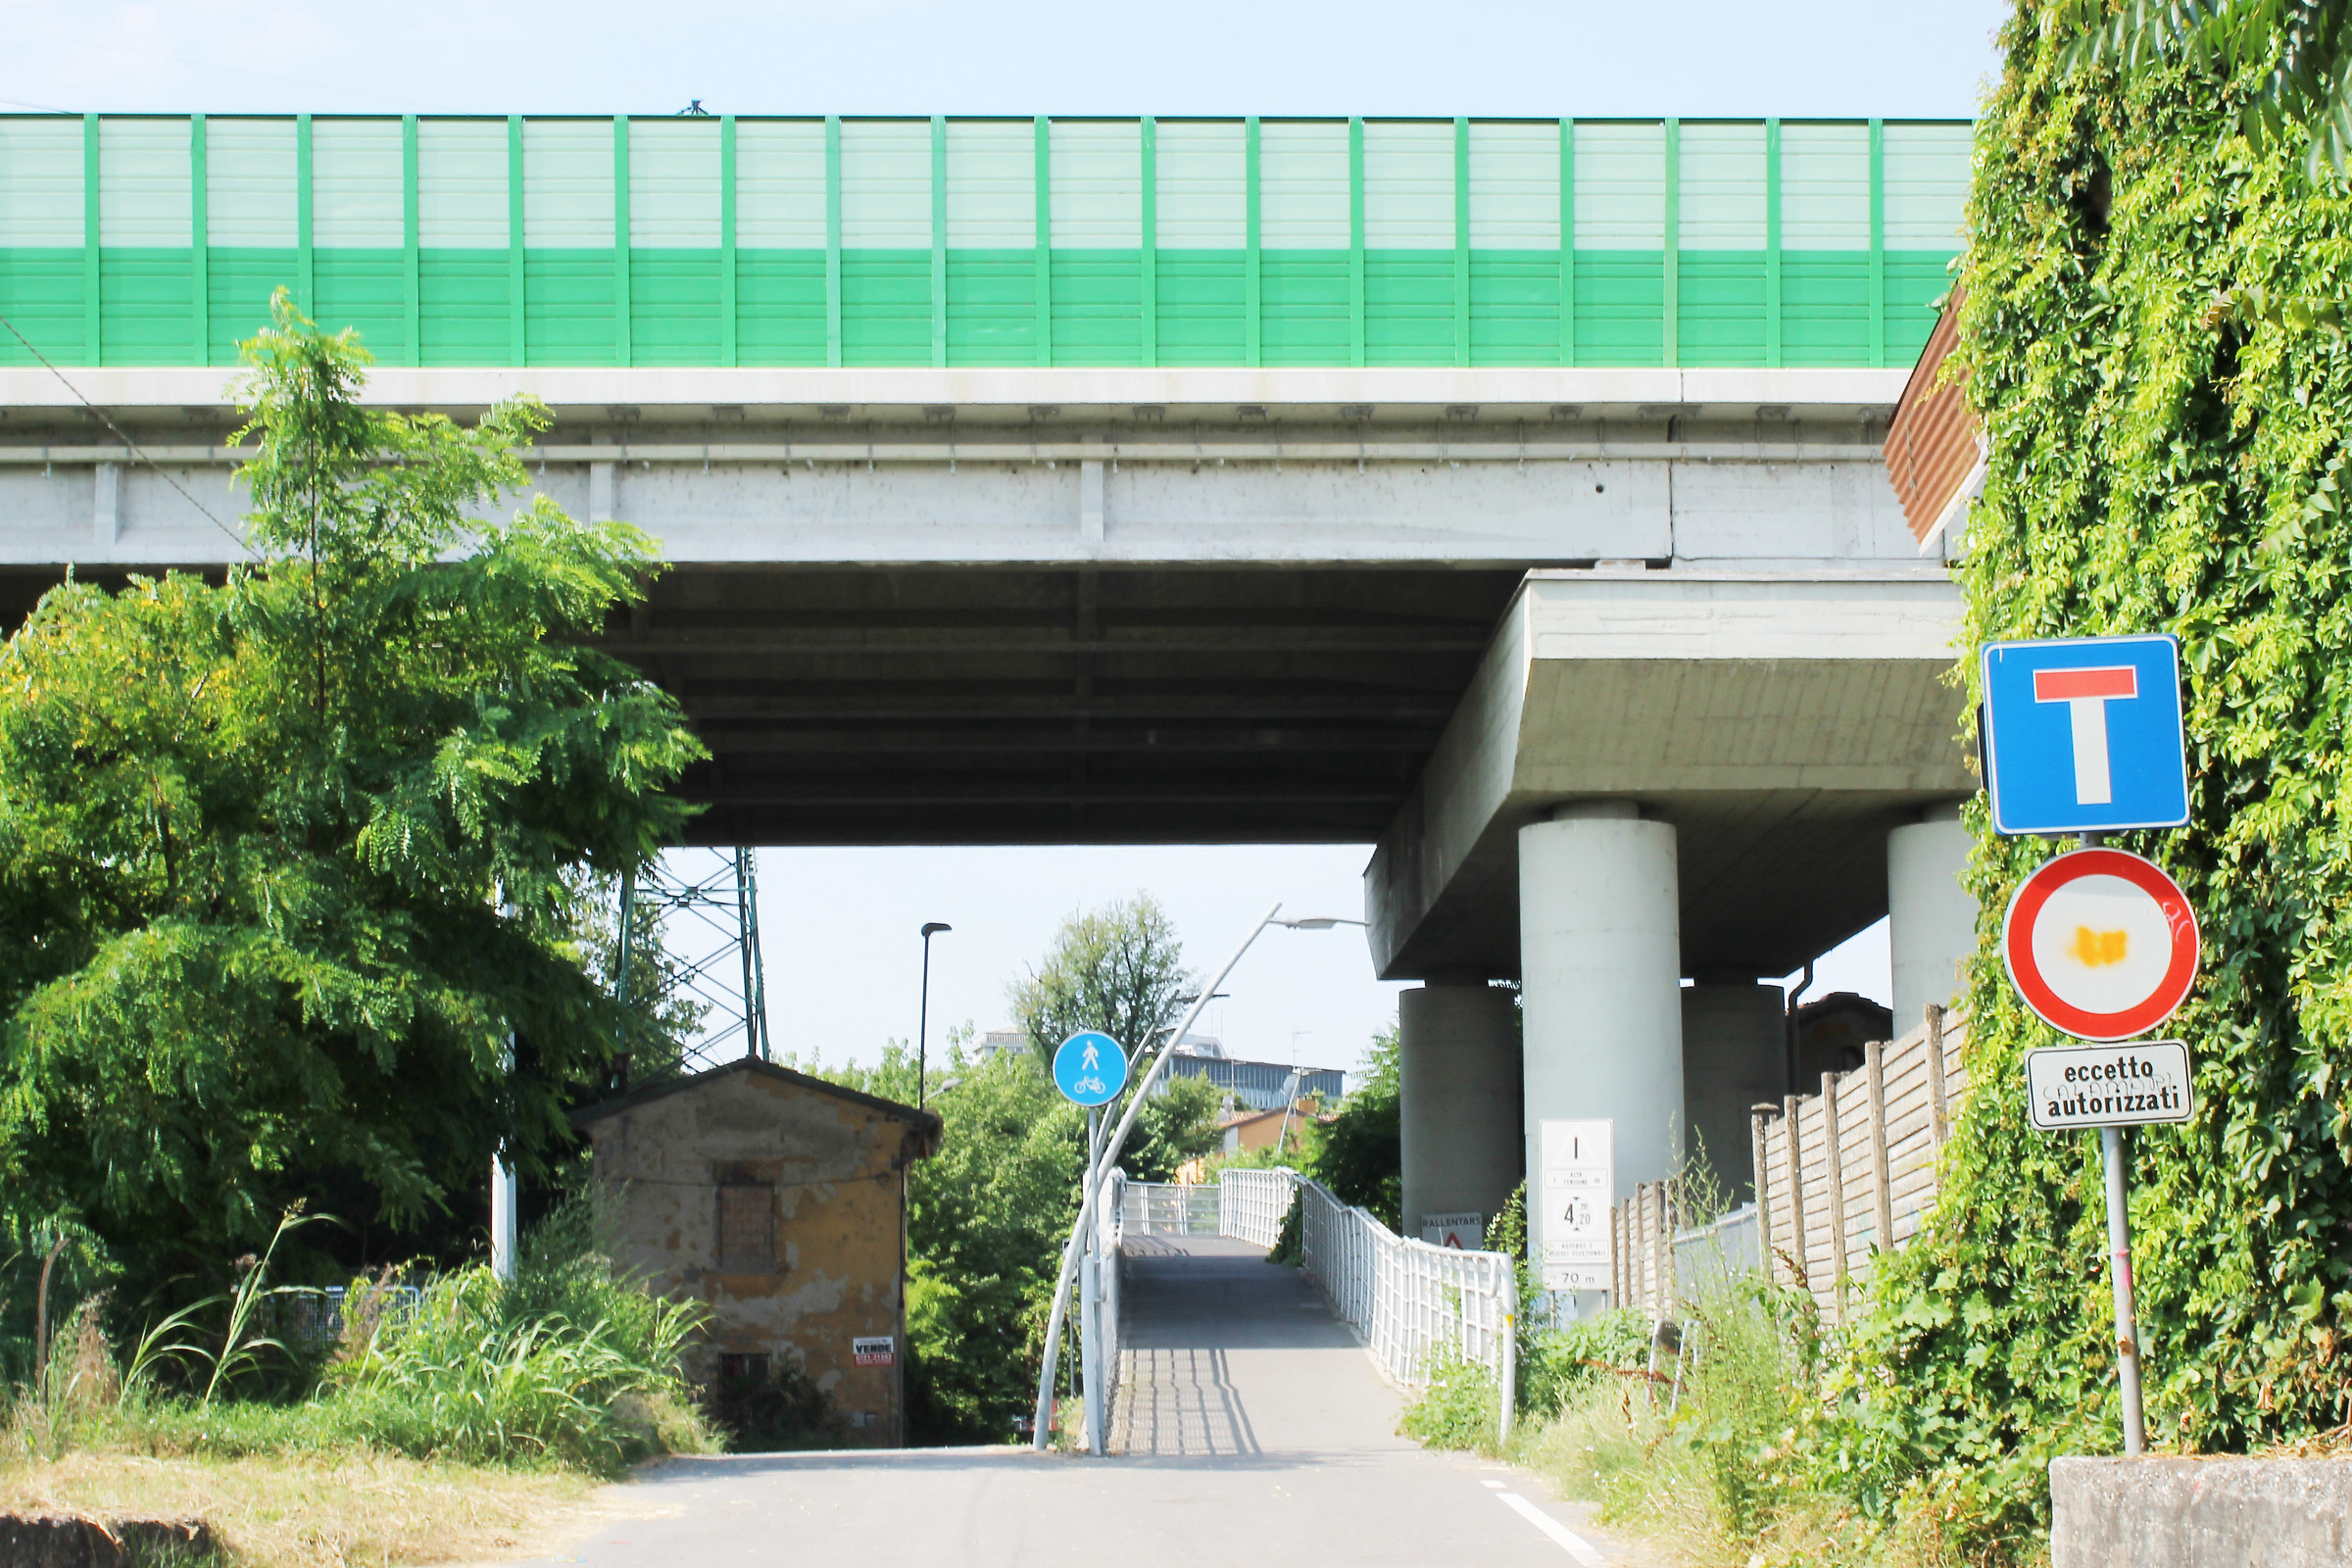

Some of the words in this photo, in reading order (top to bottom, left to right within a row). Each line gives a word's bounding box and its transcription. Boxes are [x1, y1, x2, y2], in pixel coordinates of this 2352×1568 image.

[2064, 1055, 2153, 1083] eccetto
[2047, 1085, 2180, 1118] autorizzati
[1564, 1203, 1574, 1225] 4
[1561, 1272, 1579, 1284] 70
[856, 1344, 892, 1353] VENDE
